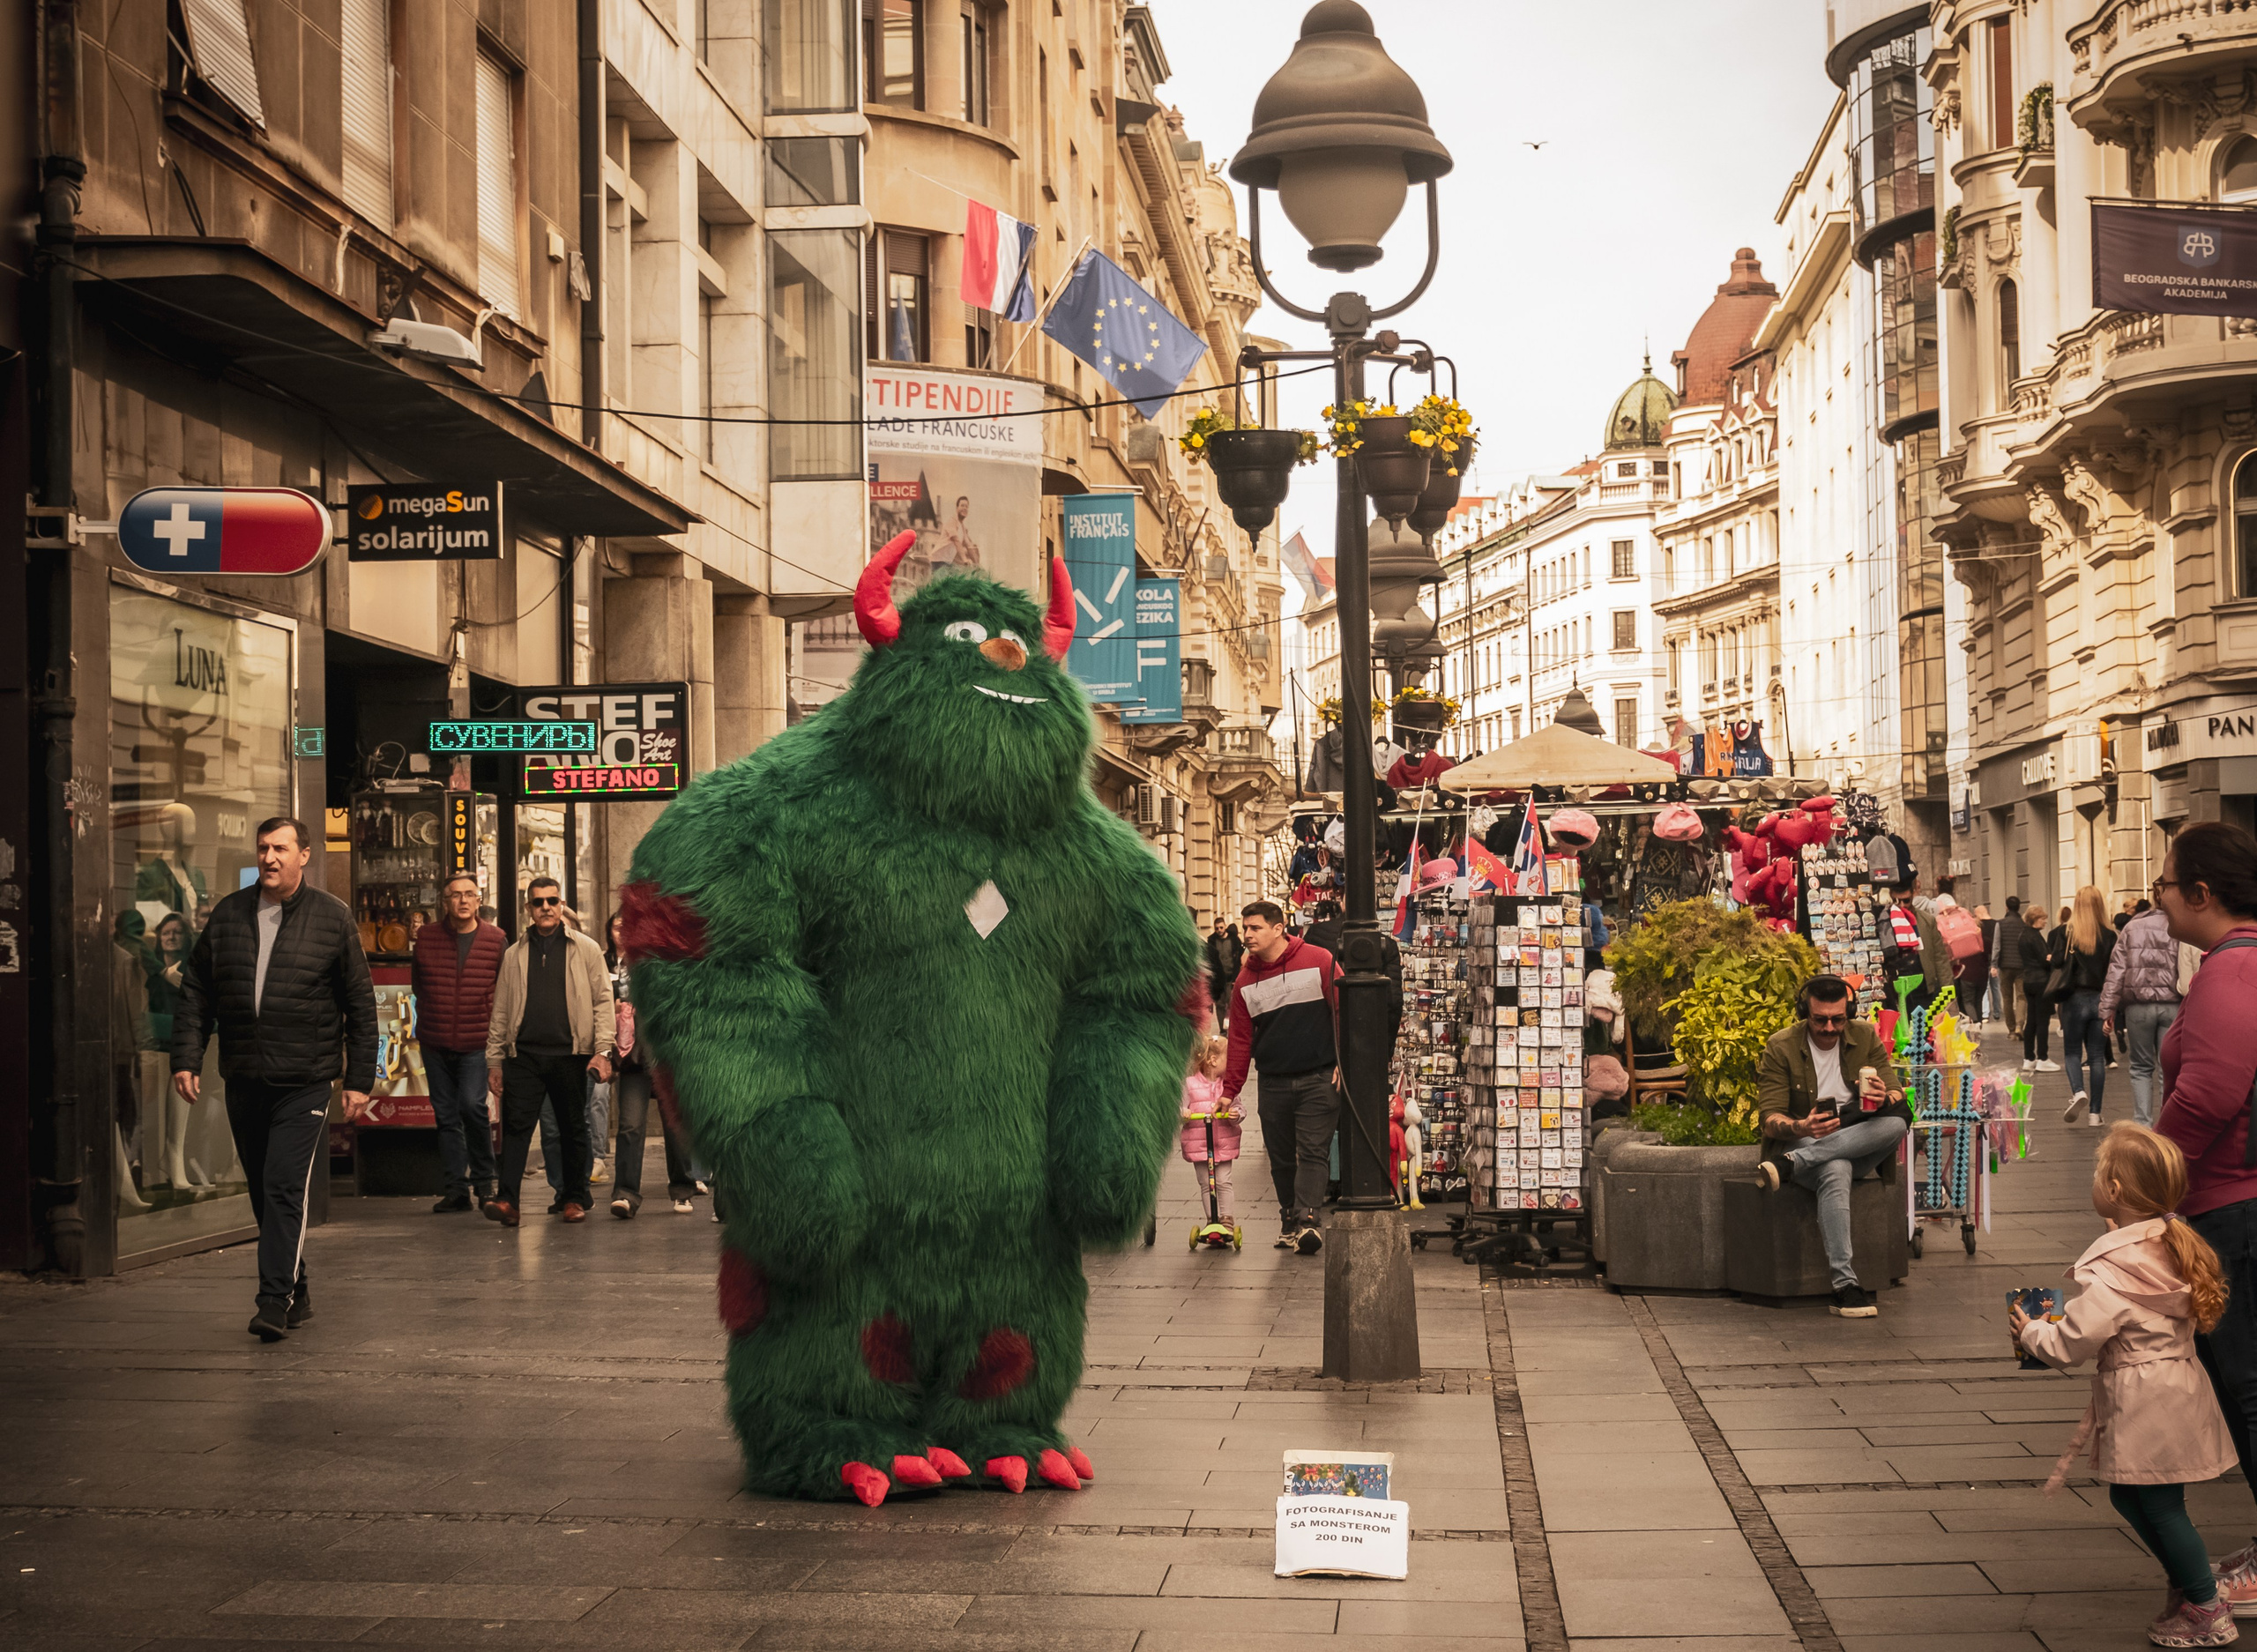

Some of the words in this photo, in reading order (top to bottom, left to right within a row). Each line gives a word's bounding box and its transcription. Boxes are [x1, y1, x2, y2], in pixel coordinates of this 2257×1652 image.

[2123, 273, 2199, 286] BEOGRADSKA
[2164, 287, 2228, 300] AKADEMIJA
[922, 420, 1015, 443] FRANCUSKE
[389, 490, 489, 517] megaSun
[1069, 513, 1123, 527] INSTITUT
[358, 525, 489, 555] solarijum
[525, 694, 675, 731] STEF
[436, 725, 595, 748] СУВЕНИРЫ
[640, 732, 677, 749] Shoe
[642, 748, 673, 763] Art
[553, 768, 660, 789] STEFANO
[454, 799, 466, 874] SOUVE
[1285, 1506, 1397, 1522] FOTOGRAFISANJE
[1290, 1521, 1307, 1529] SA
[1310, 1520, 1391, 1535] MONSTEROM
[1341, 1535, 1363, 1544] DIN
